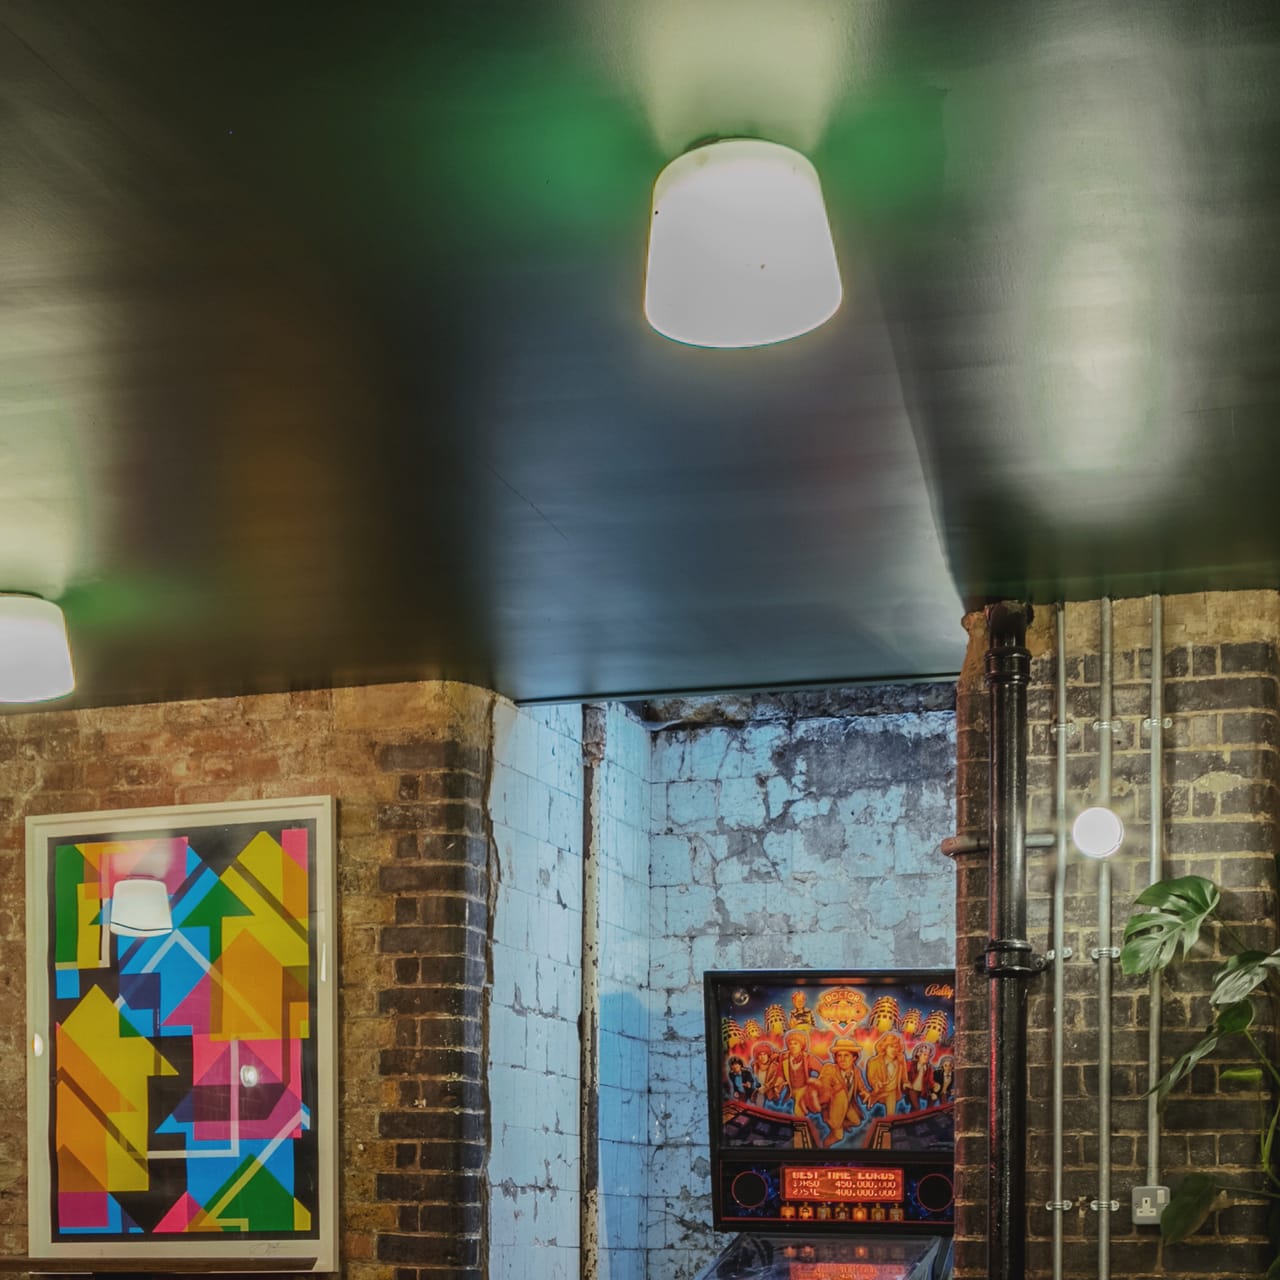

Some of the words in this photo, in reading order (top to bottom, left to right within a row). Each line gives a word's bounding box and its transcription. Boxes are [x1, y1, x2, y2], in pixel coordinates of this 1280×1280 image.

[824, 991, 861, 1002] DOCTOR
[924, 984, 955, 1000] Bally
[827, 1171, 851, 1180] TIME
